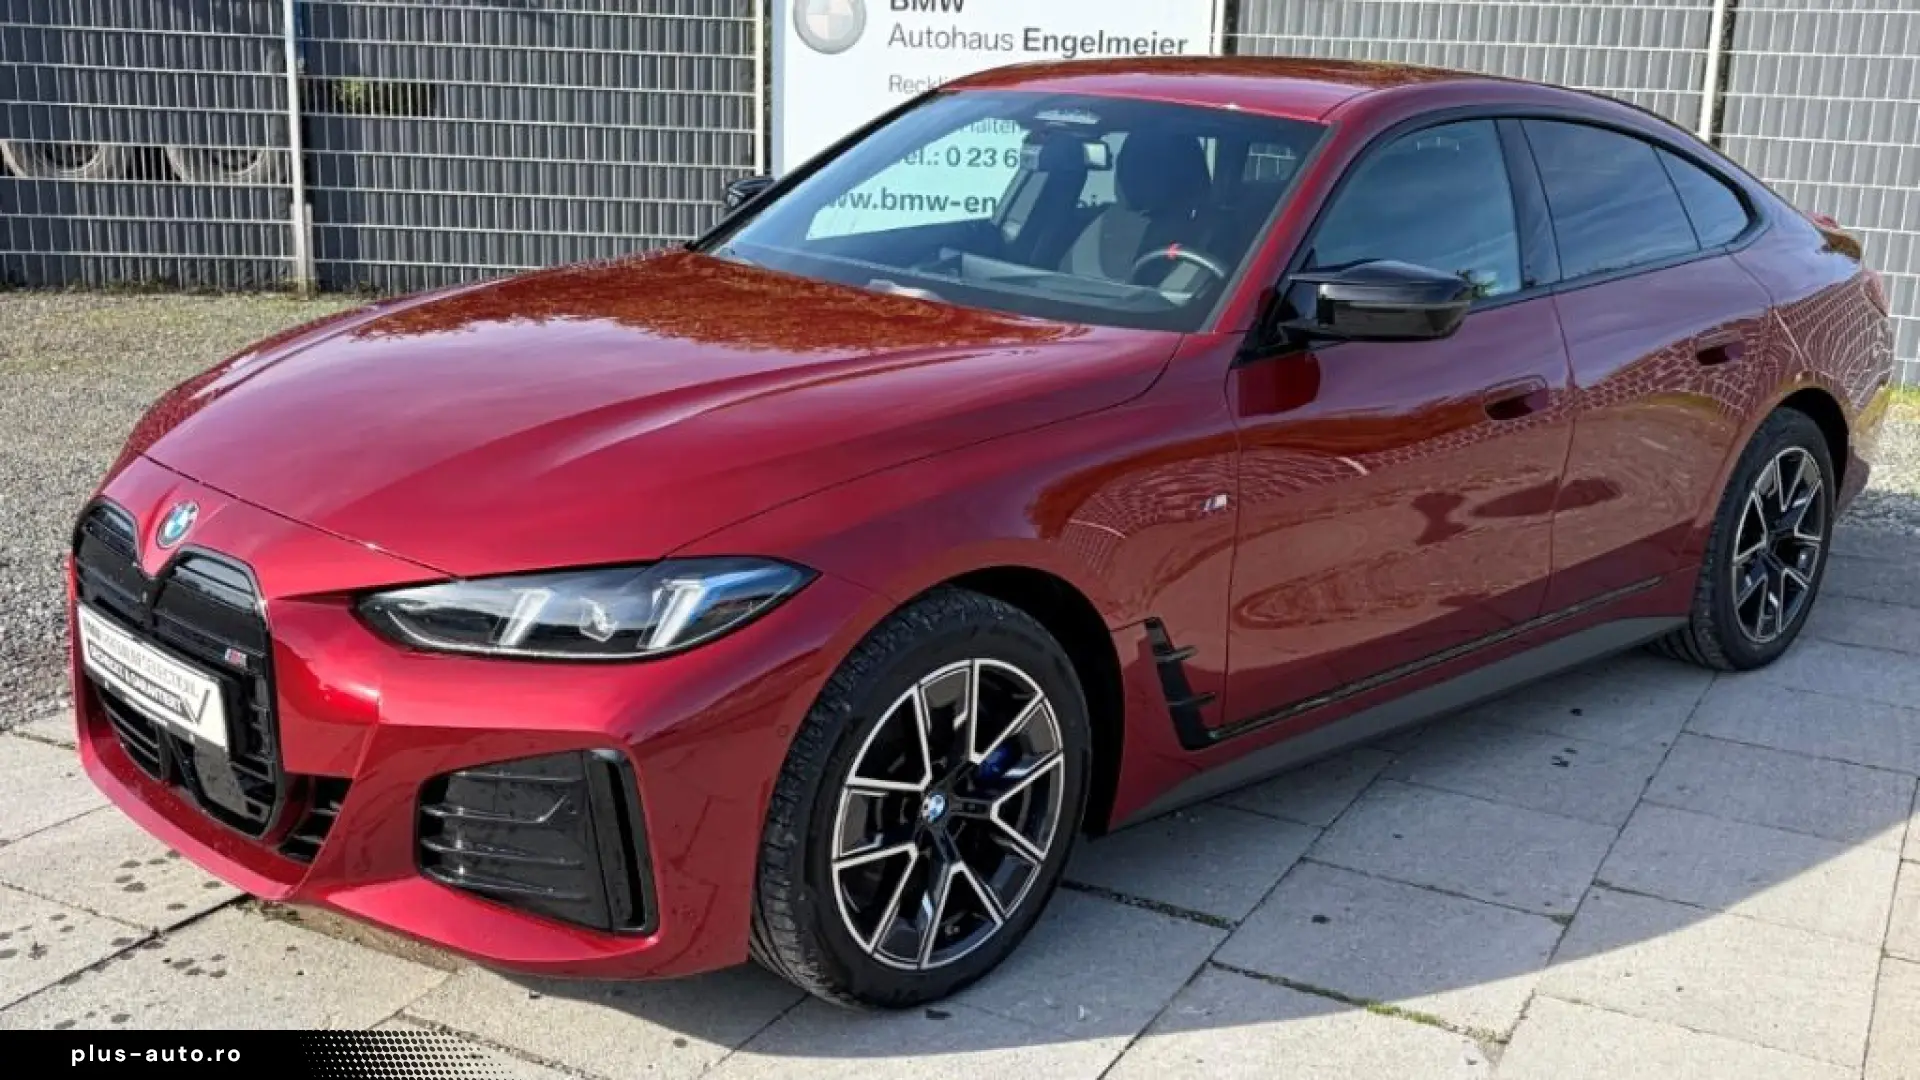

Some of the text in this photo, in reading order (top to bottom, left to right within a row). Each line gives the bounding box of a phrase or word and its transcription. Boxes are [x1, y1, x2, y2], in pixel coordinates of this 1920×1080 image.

[887, 23, 1189, 58] Autohaus Engelmeier
[946, 148, 962, 168] 0
[966, 148, 998, 168] 23
[1003, 149, 1019, 168] 6
